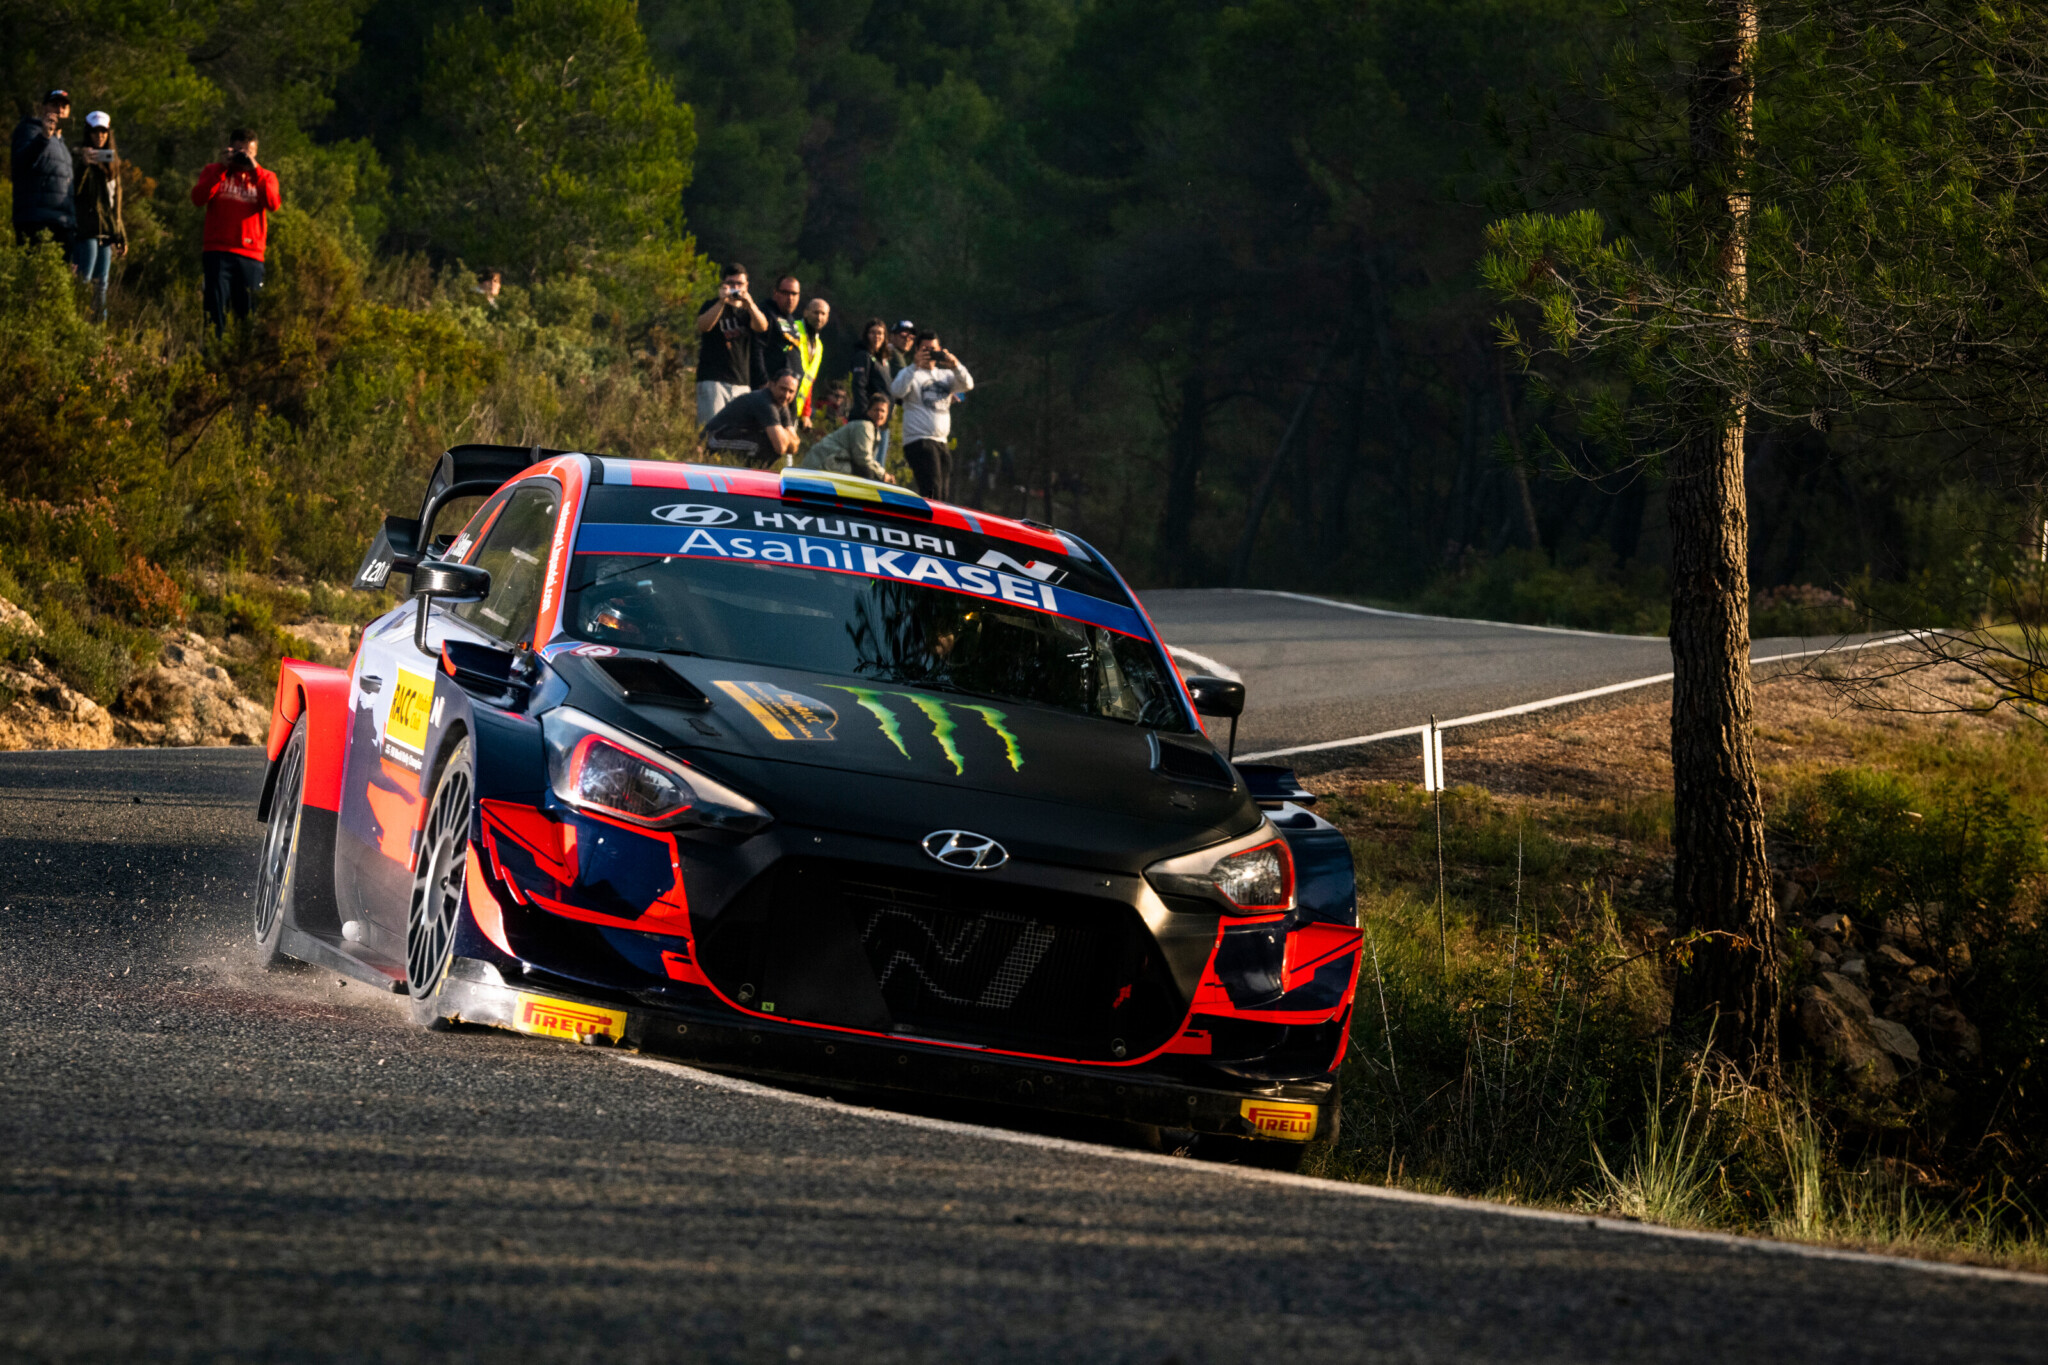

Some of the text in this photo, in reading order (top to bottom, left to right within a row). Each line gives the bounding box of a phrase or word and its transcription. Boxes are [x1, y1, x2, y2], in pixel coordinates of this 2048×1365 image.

[753, 511, 956, 556] HYUNDAI
[678, 529, 1058, 612] AsahiKASEI
[390, 683, 417, 726] RACC
[523, 1001, 613, 1036] PIRELLI
[1248, 1107, 1311, 1133] PIRELLI
